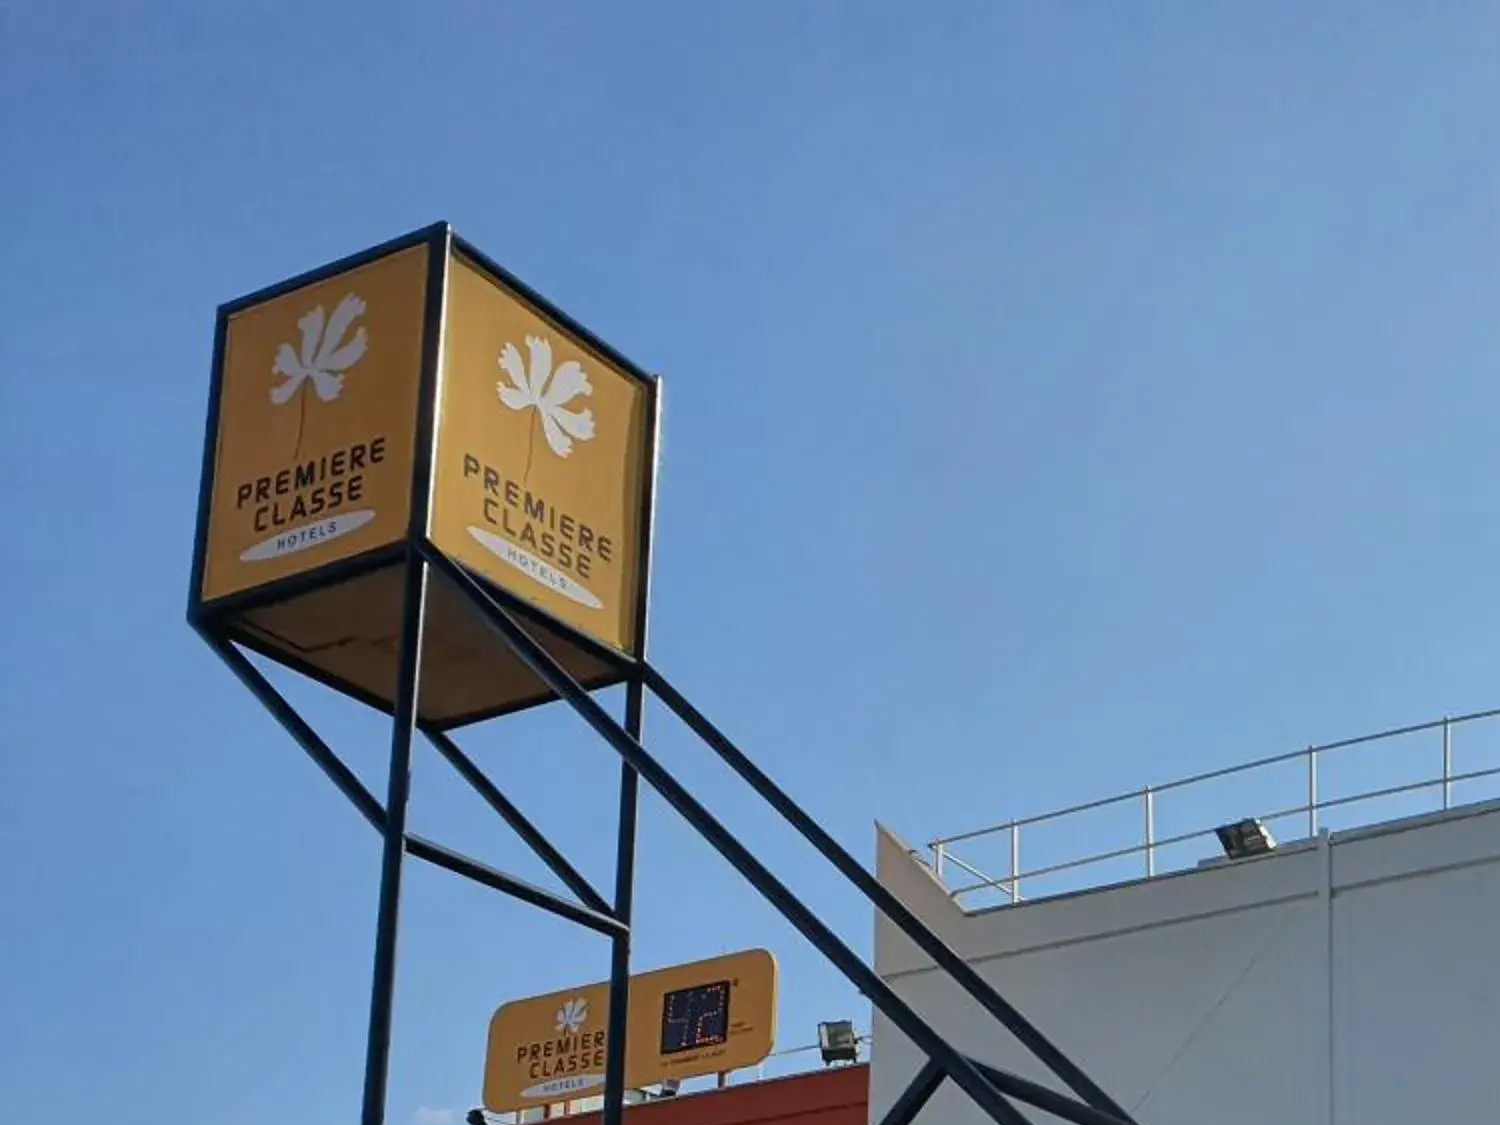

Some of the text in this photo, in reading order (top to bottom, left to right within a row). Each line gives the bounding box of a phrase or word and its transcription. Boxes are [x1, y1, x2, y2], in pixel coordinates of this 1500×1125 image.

[237, 437, 386, 510] PREMIERE
[254, 474, 363, 532] CLASSE
[464, 452, 613, 563] PREMIERE
[276, 521, 337, 551] HOTELS
[484, 498, 591, 579] CLASSE
[507, 546, 568, 589] HOTELS
[517, 1031, 606, 1065] PREMIER
[529, 1050, 605, 1079] CLASSE
